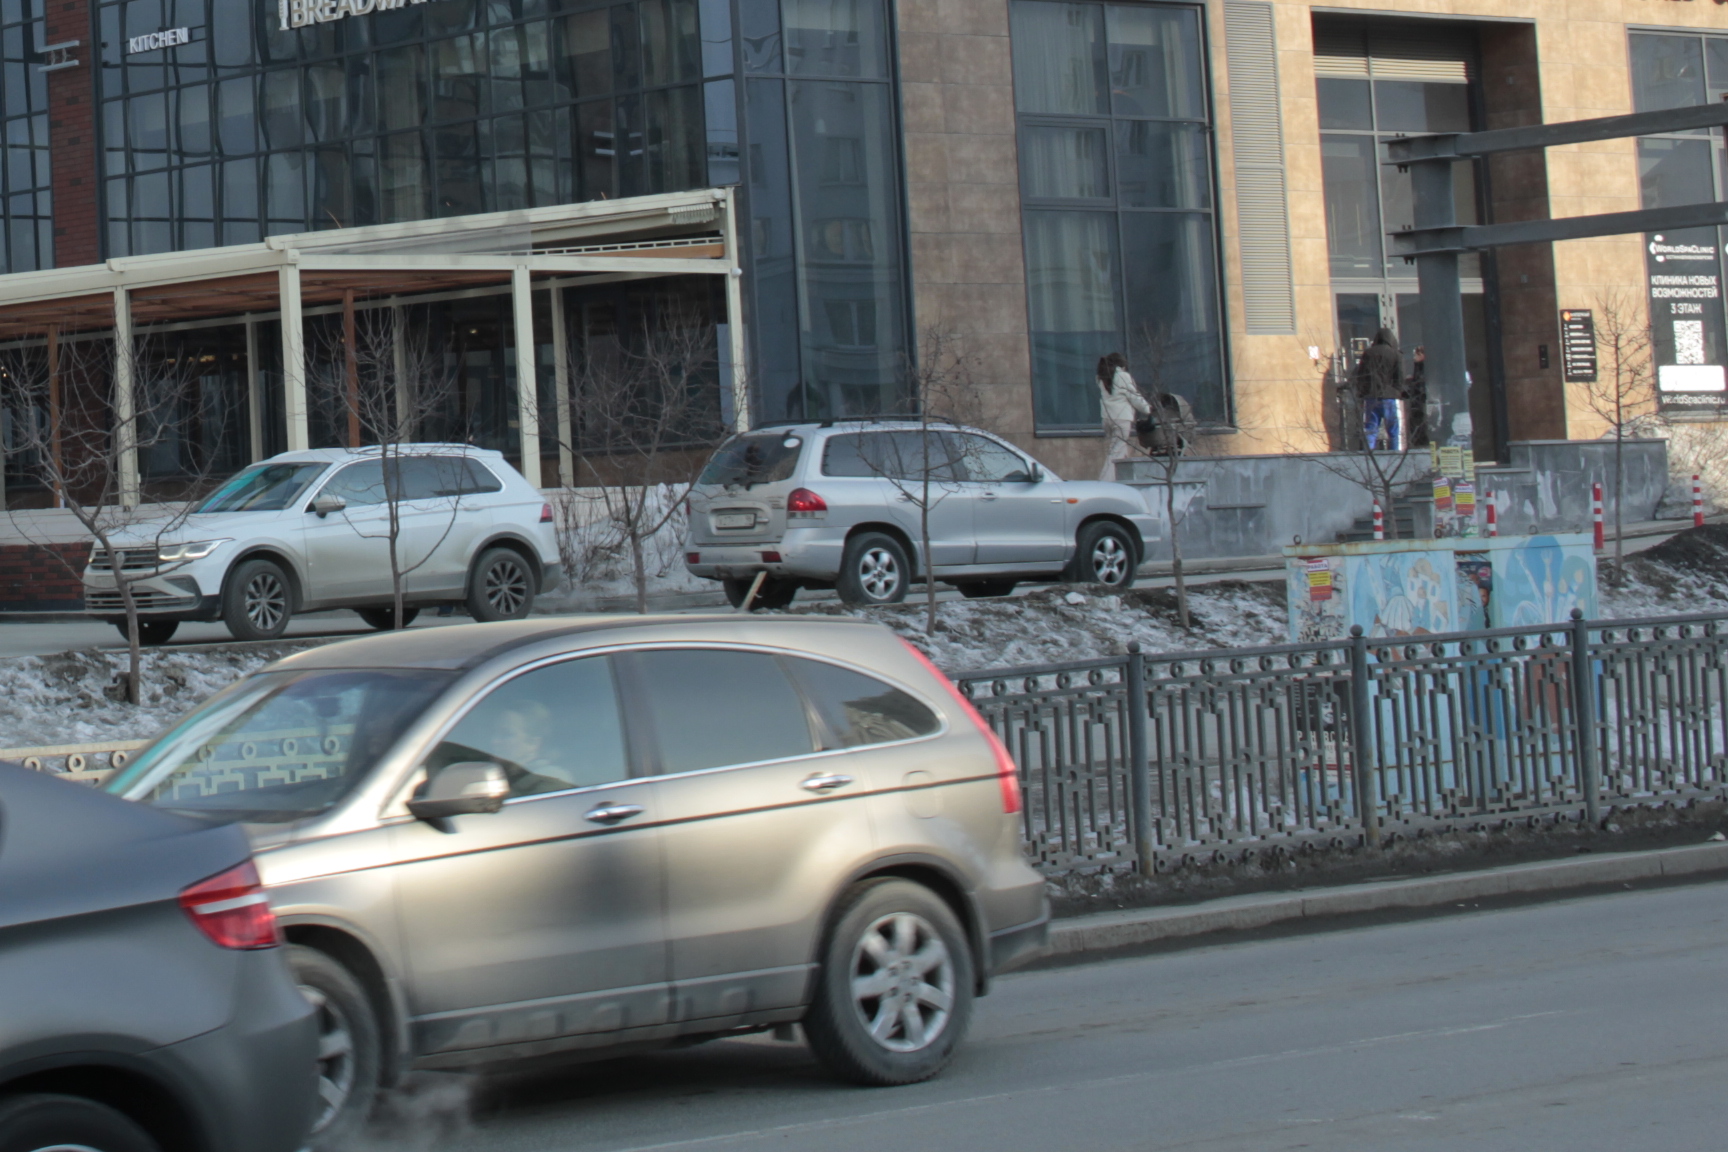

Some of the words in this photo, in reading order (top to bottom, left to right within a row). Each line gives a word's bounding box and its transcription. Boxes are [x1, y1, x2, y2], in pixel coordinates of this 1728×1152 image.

[129, 27, 189, 54] KITCHEN
[1651, 275, 1688, 286] КЛИНИКА
[1688, 275, 1717, 286] НОВЫХ
[1652, 286, 1718, 298] ВОЗМОЖНОСТЕЙ
[1677, 303, 1703, 314] ЭТАЖ
